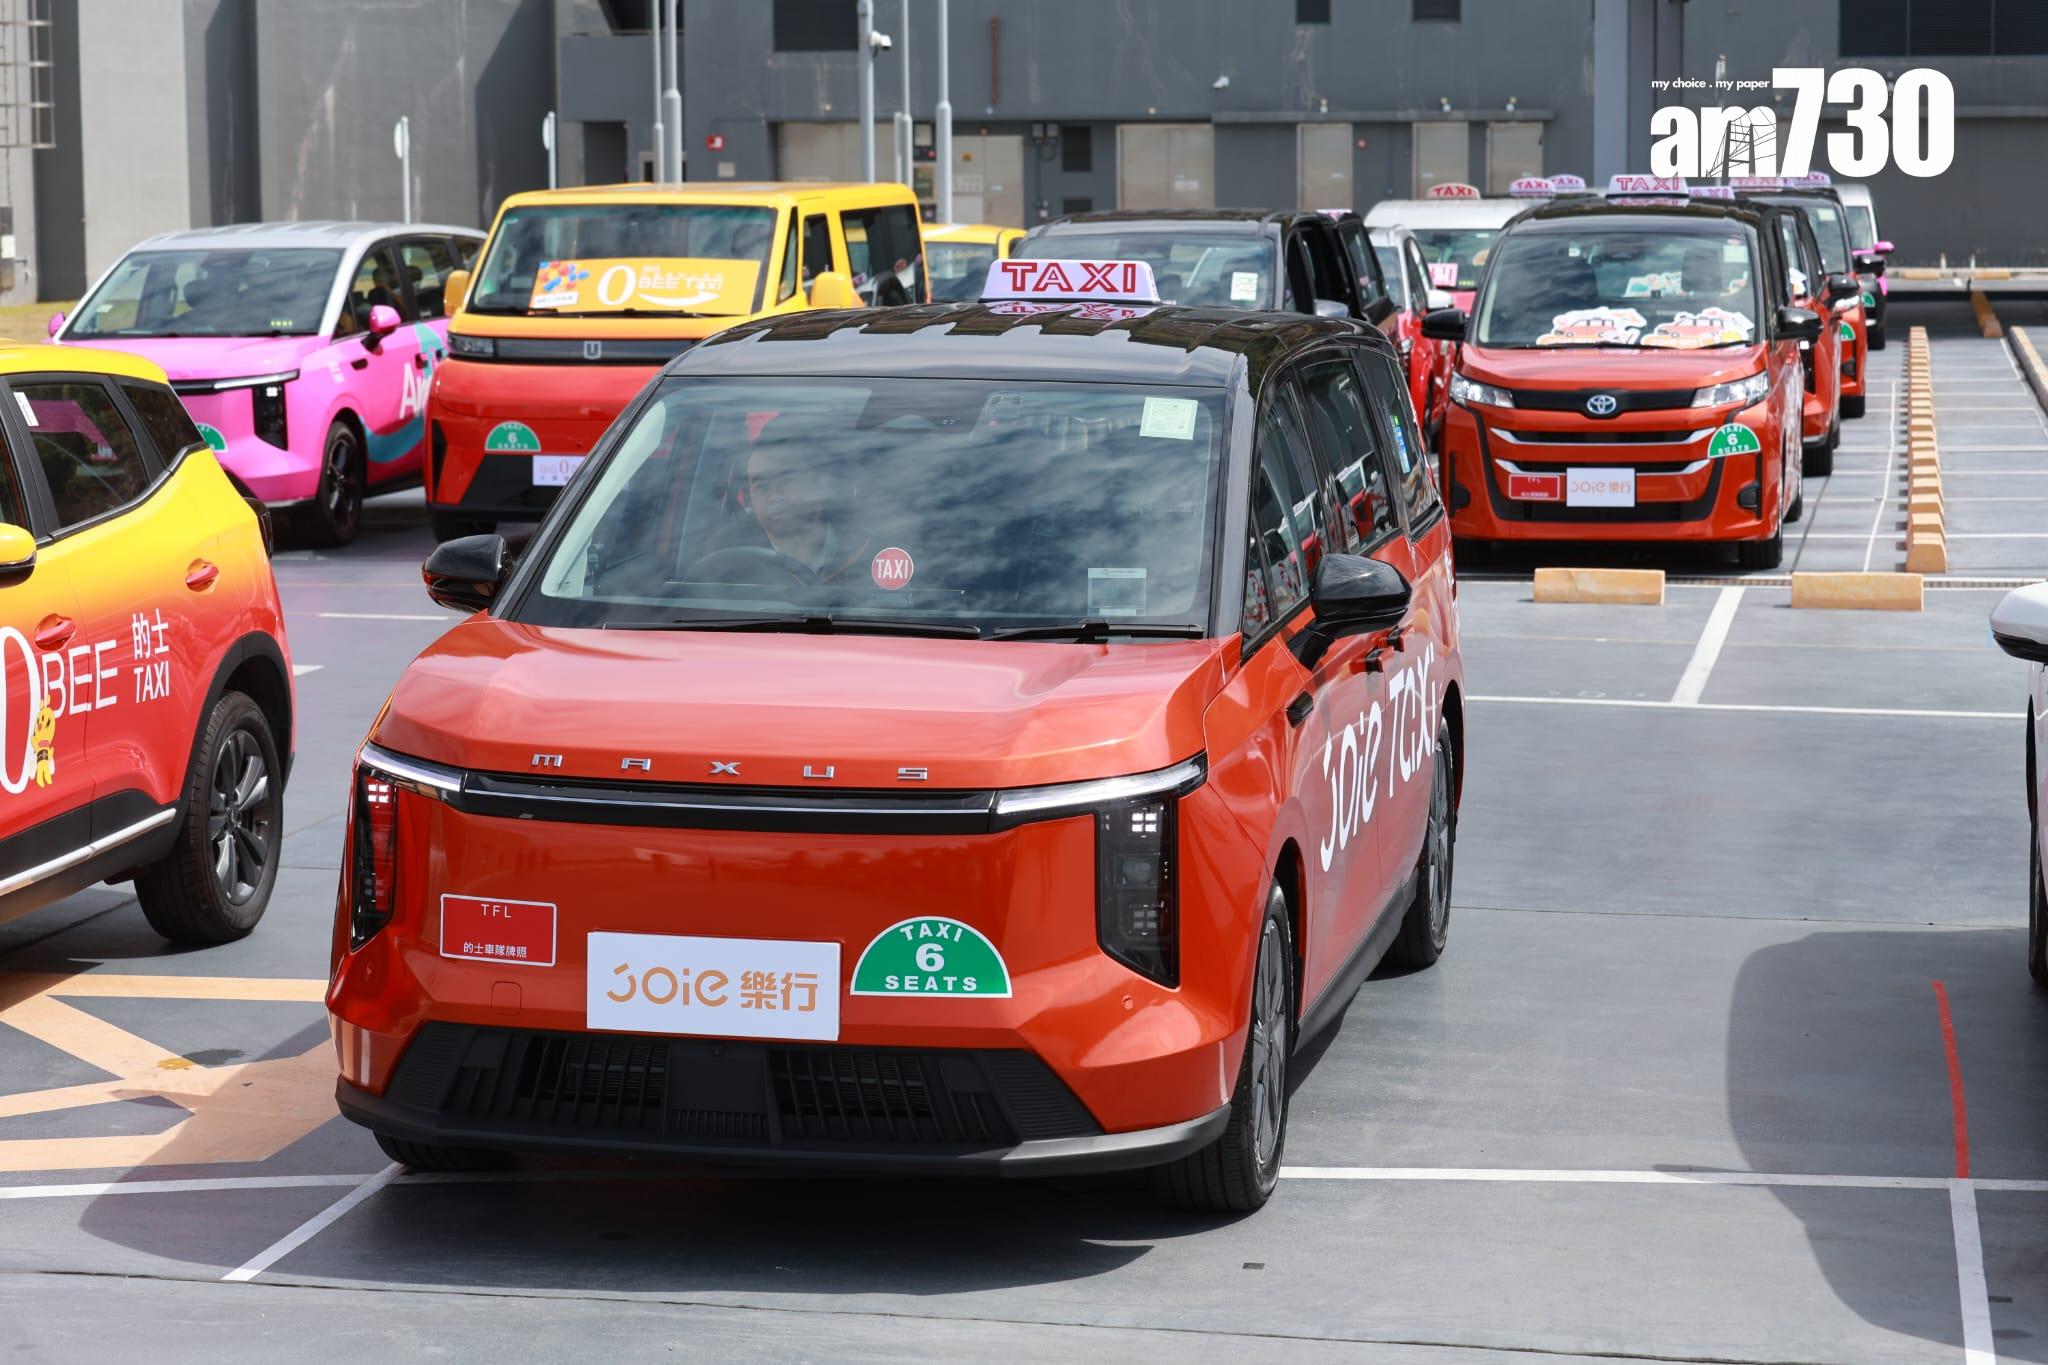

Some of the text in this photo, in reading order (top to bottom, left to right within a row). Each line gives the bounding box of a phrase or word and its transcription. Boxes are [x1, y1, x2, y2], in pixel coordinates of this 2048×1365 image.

[1433, 187, 1473, 197] TAXI
[1516, 181, 1549, 190] TAXI
[1616, 177, 1680, 191] TAXI
[1001, 262, 1137, 293] TAXI
[508, 432, 518, 444] 6
[1727, 433, 1738, 445] 6
[875, 558, 909, 579] TAXI
[131, 608, 170, 660] 的士
[41, 639, 119, 719] BEE
[133, 661, 170, 704] TAXI
[531, 753, 928, 781] MAXUS
[480, 903, 512, 918] TFL
[899, 922, 964, 942] TAXI
[463, 942, 528, 958] 的士車隊牌照
[915, 942, 945, 972] 6
[740, 970, 818, 1012] 樂行
[885, 975, 977, 991] SEATS
